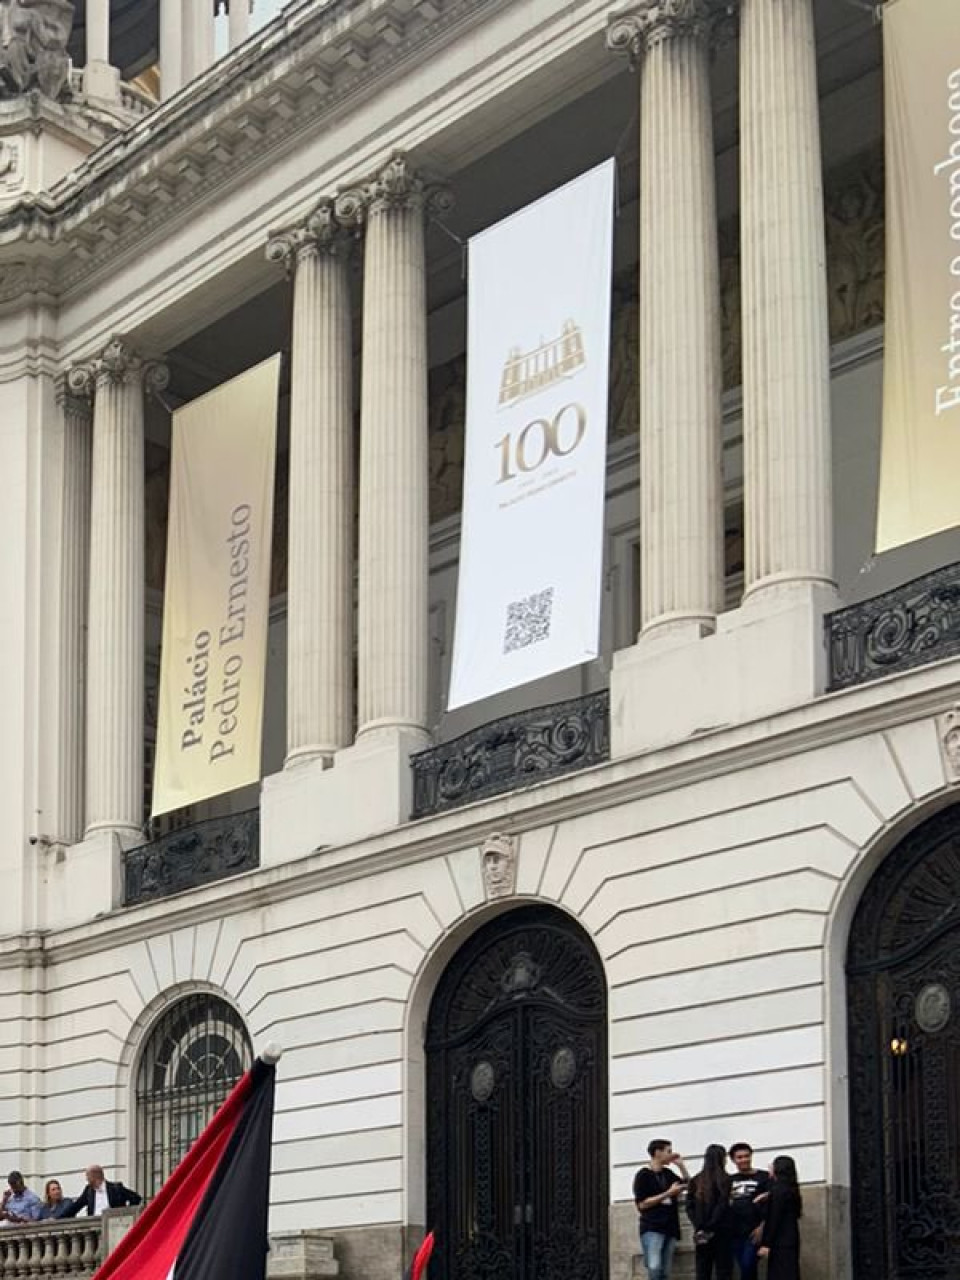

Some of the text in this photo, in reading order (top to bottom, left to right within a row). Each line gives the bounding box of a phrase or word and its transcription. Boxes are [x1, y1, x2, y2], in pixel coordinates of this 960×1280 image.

[494, 402, 586, 485] 100
[181, 630, 211, 752] Palácio
[208, 503, 251, 765] Pedro Ernesto
